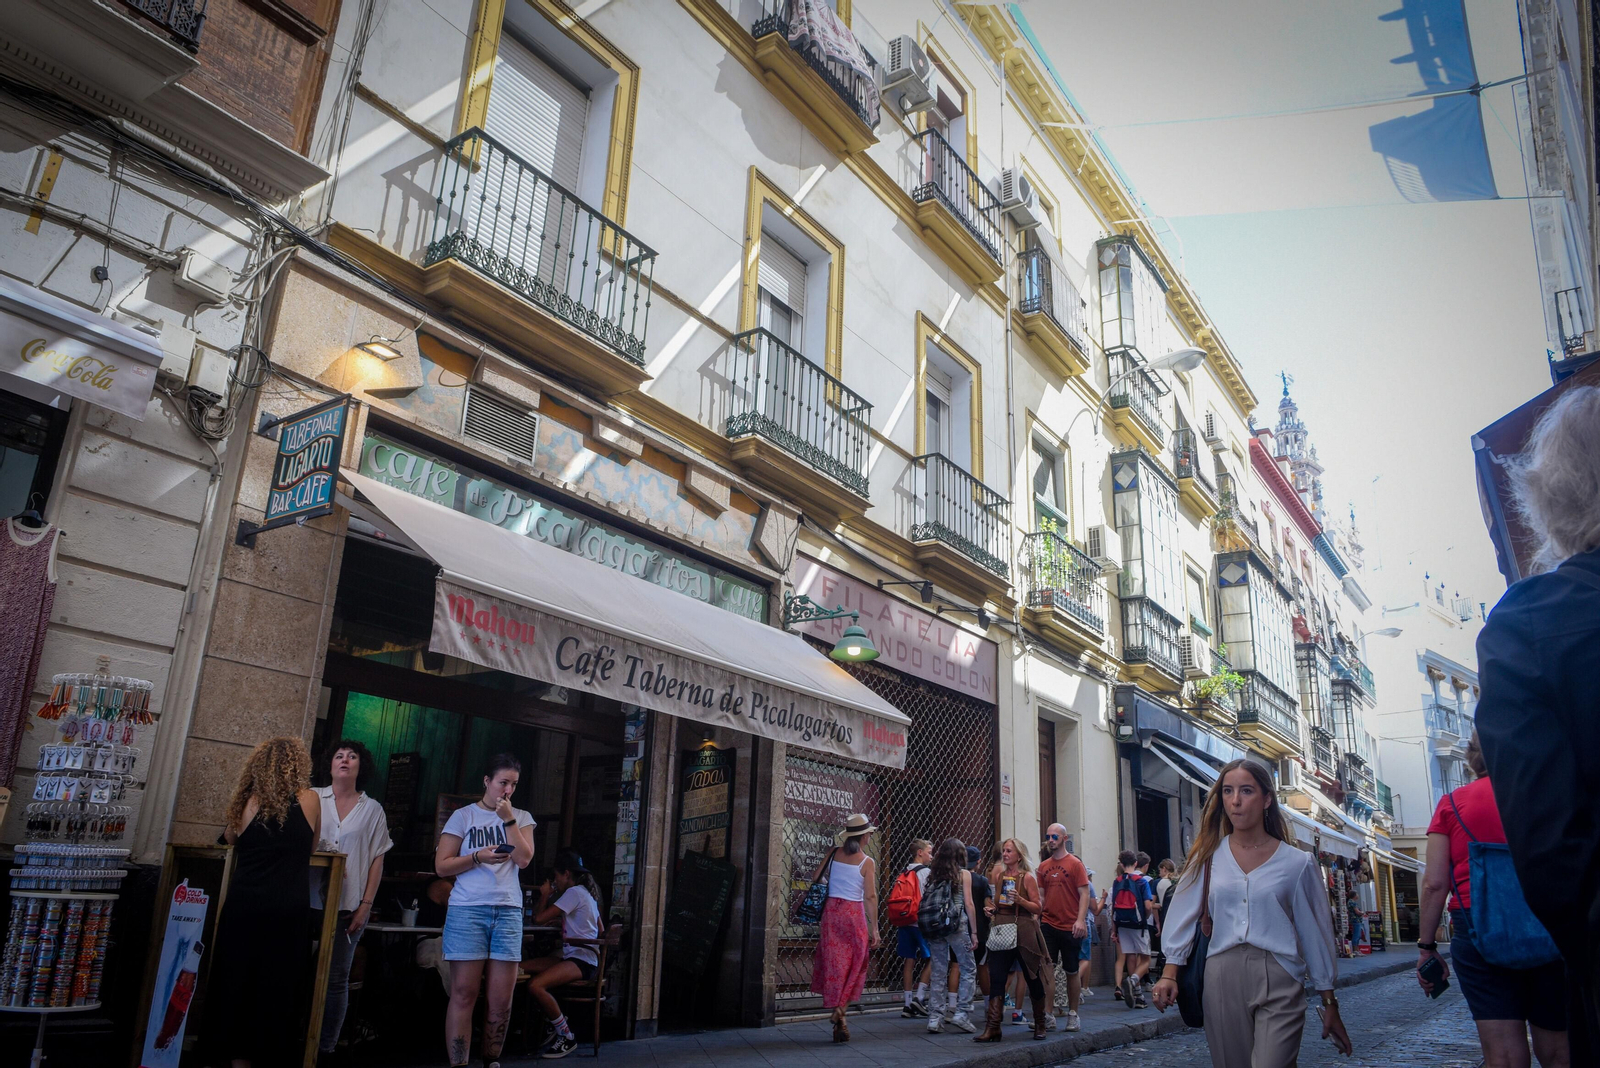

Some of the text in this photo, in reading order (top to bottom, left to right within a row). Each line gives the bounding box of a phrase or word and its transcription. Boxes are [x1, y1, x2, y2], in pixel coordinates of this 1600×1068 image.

[285, 413, 333, 451] TABERNA
[279, 437, 334, 487] LAGARTO
[469, 487, 488, 508] de
[447, 593, 535, 645] Mahou
[822, 576, 978, 662] FILATELIA
[555, 636, 853, 745] Café Taberna de Picalagartos
[932, 655, 991, 695] COLON
[863, 720, 905, 747] Mahou
[687, 768, 724, 792] Tapas
[680, 815, 716, 834] SANDWICH
[185, 897, 208, 905] DRINKS
